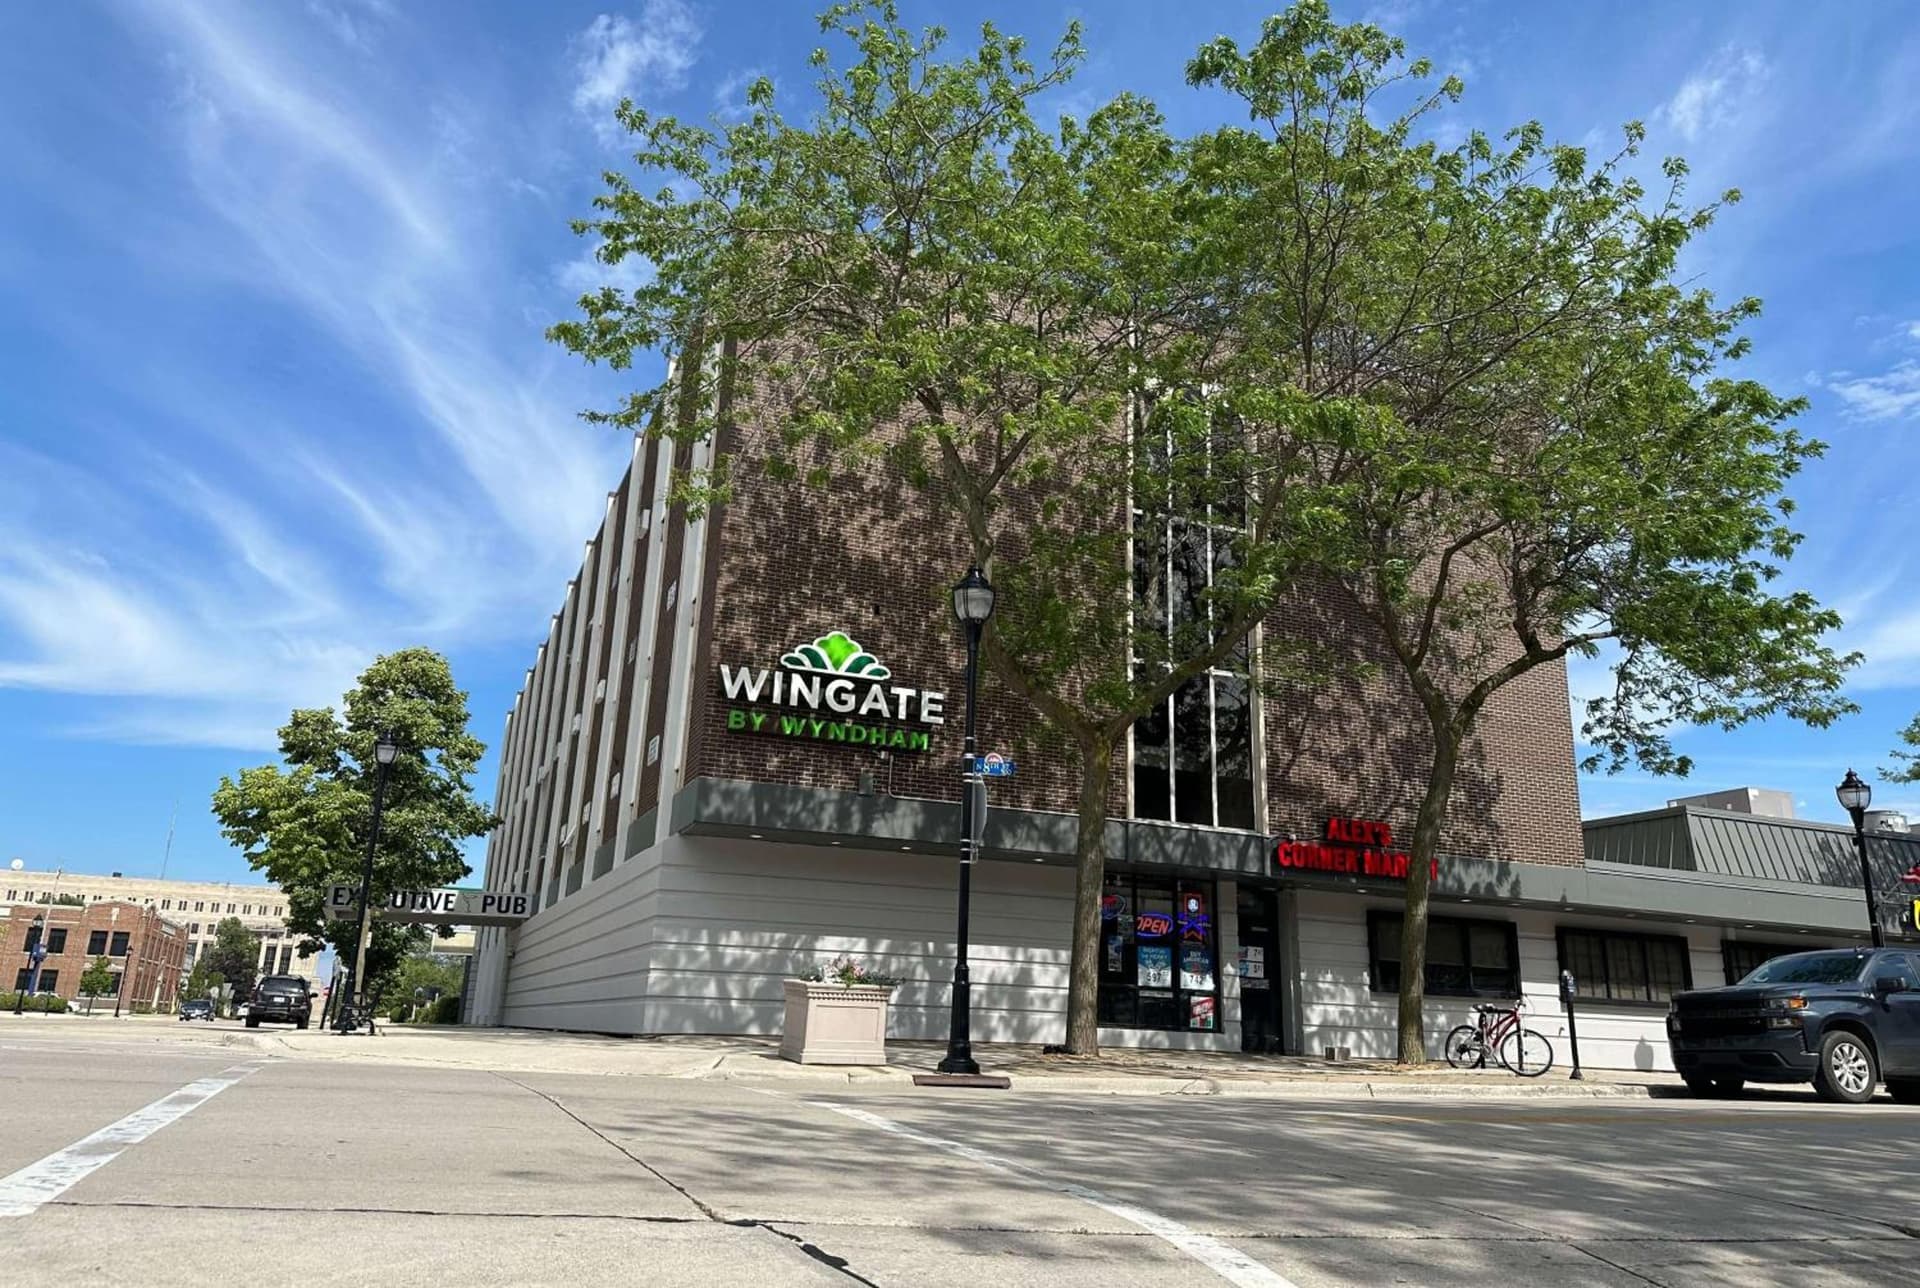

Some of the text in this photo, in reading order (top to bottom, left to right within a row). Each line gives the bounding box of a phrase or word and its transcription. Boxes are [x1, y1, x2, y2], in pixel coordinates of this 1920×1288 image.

[719, 664, 945, 725] WINGATE
[727, 709, 929, 751] BY WYNDHAM
[1328, 816, 1392, 846] ALEX'S
[1278, 840, 1358, 873] CORNER
[332, 886, 527, 915] EXUTIVE PUB
